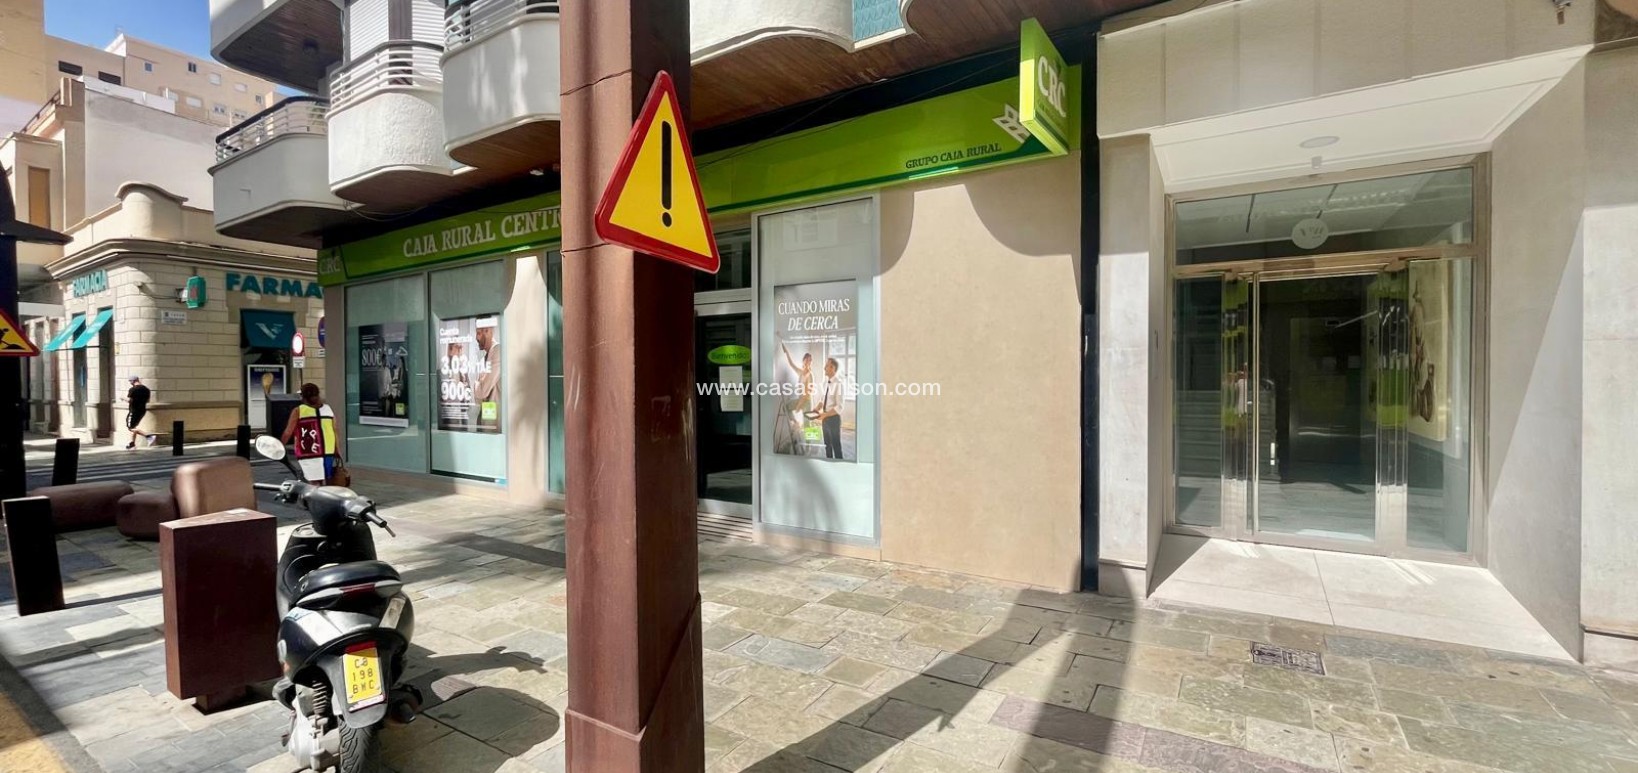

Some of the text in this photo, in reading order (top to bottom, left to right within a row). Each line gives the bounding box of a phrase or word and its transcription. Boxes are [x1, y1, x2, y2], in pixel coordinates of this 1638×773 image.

[1037, 55, 1067, 118] CRC
[905, 143, 1002, 169] GRUPO CAJA RURAL
[403, 237, 438, 258] CAJA
[441, 220, 496, 251] RURAL
[73, 269, 108, 298] FARMACIA
[226, 272, 325, 299] FARMA
[778, 298, 850, 315] CUANDO MIRAS
[787, 315, 839, 331] DE CERCA
[352, 668, 374, 682] 198
